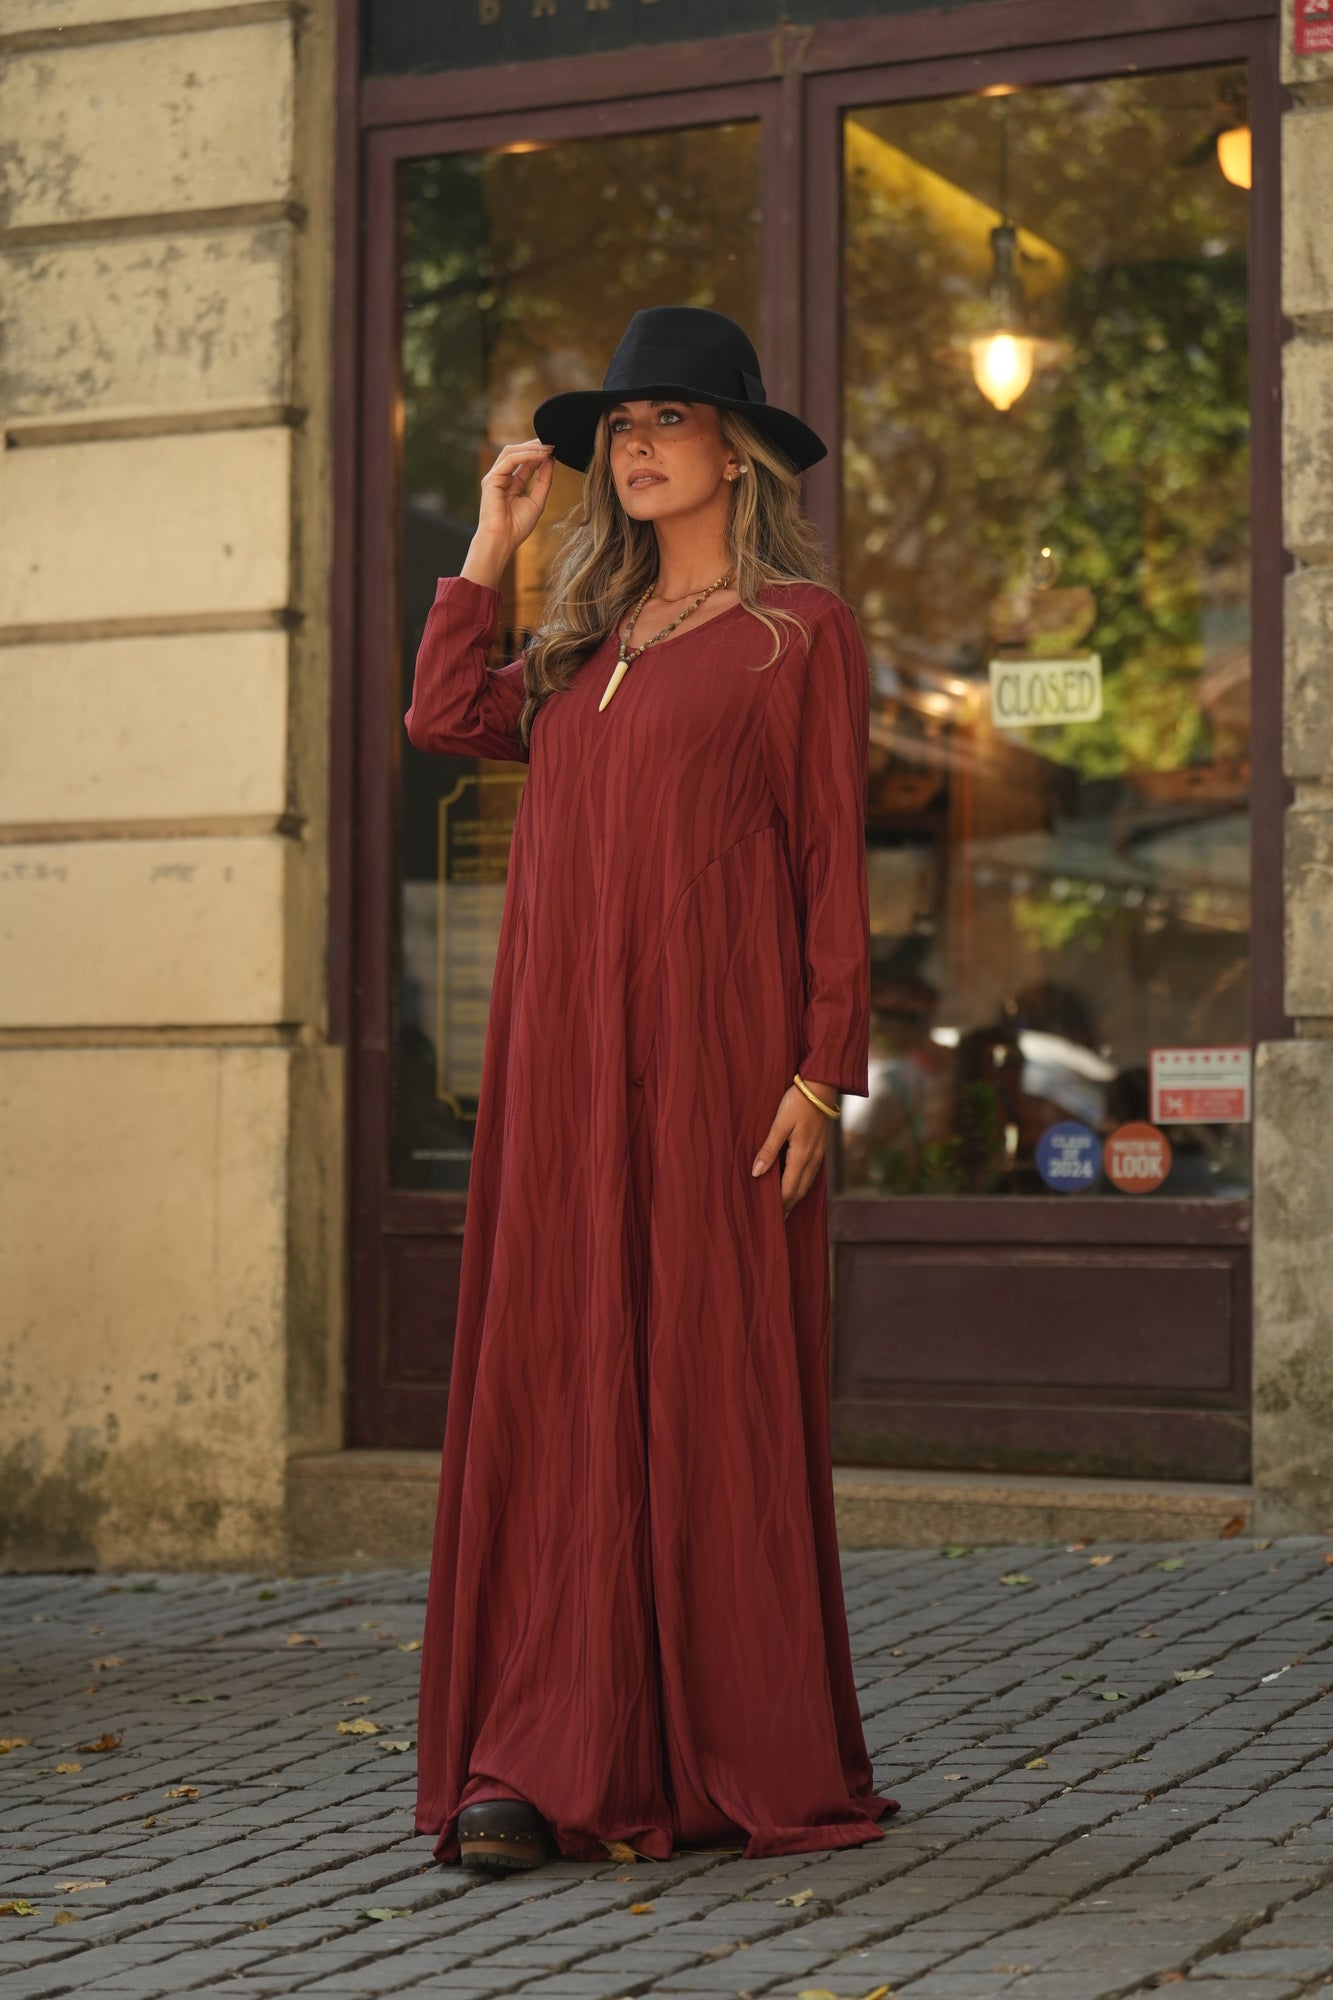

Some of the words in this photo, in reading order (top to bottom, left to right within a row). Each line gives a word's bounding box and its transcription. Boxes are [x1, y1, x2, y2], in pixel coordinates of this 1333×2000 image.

[996, 671, 1095, 716] CLOSED
[1049, 1159, 1093, 1178] 2024
[1112, 1156, 1163, 1178] LOOK
